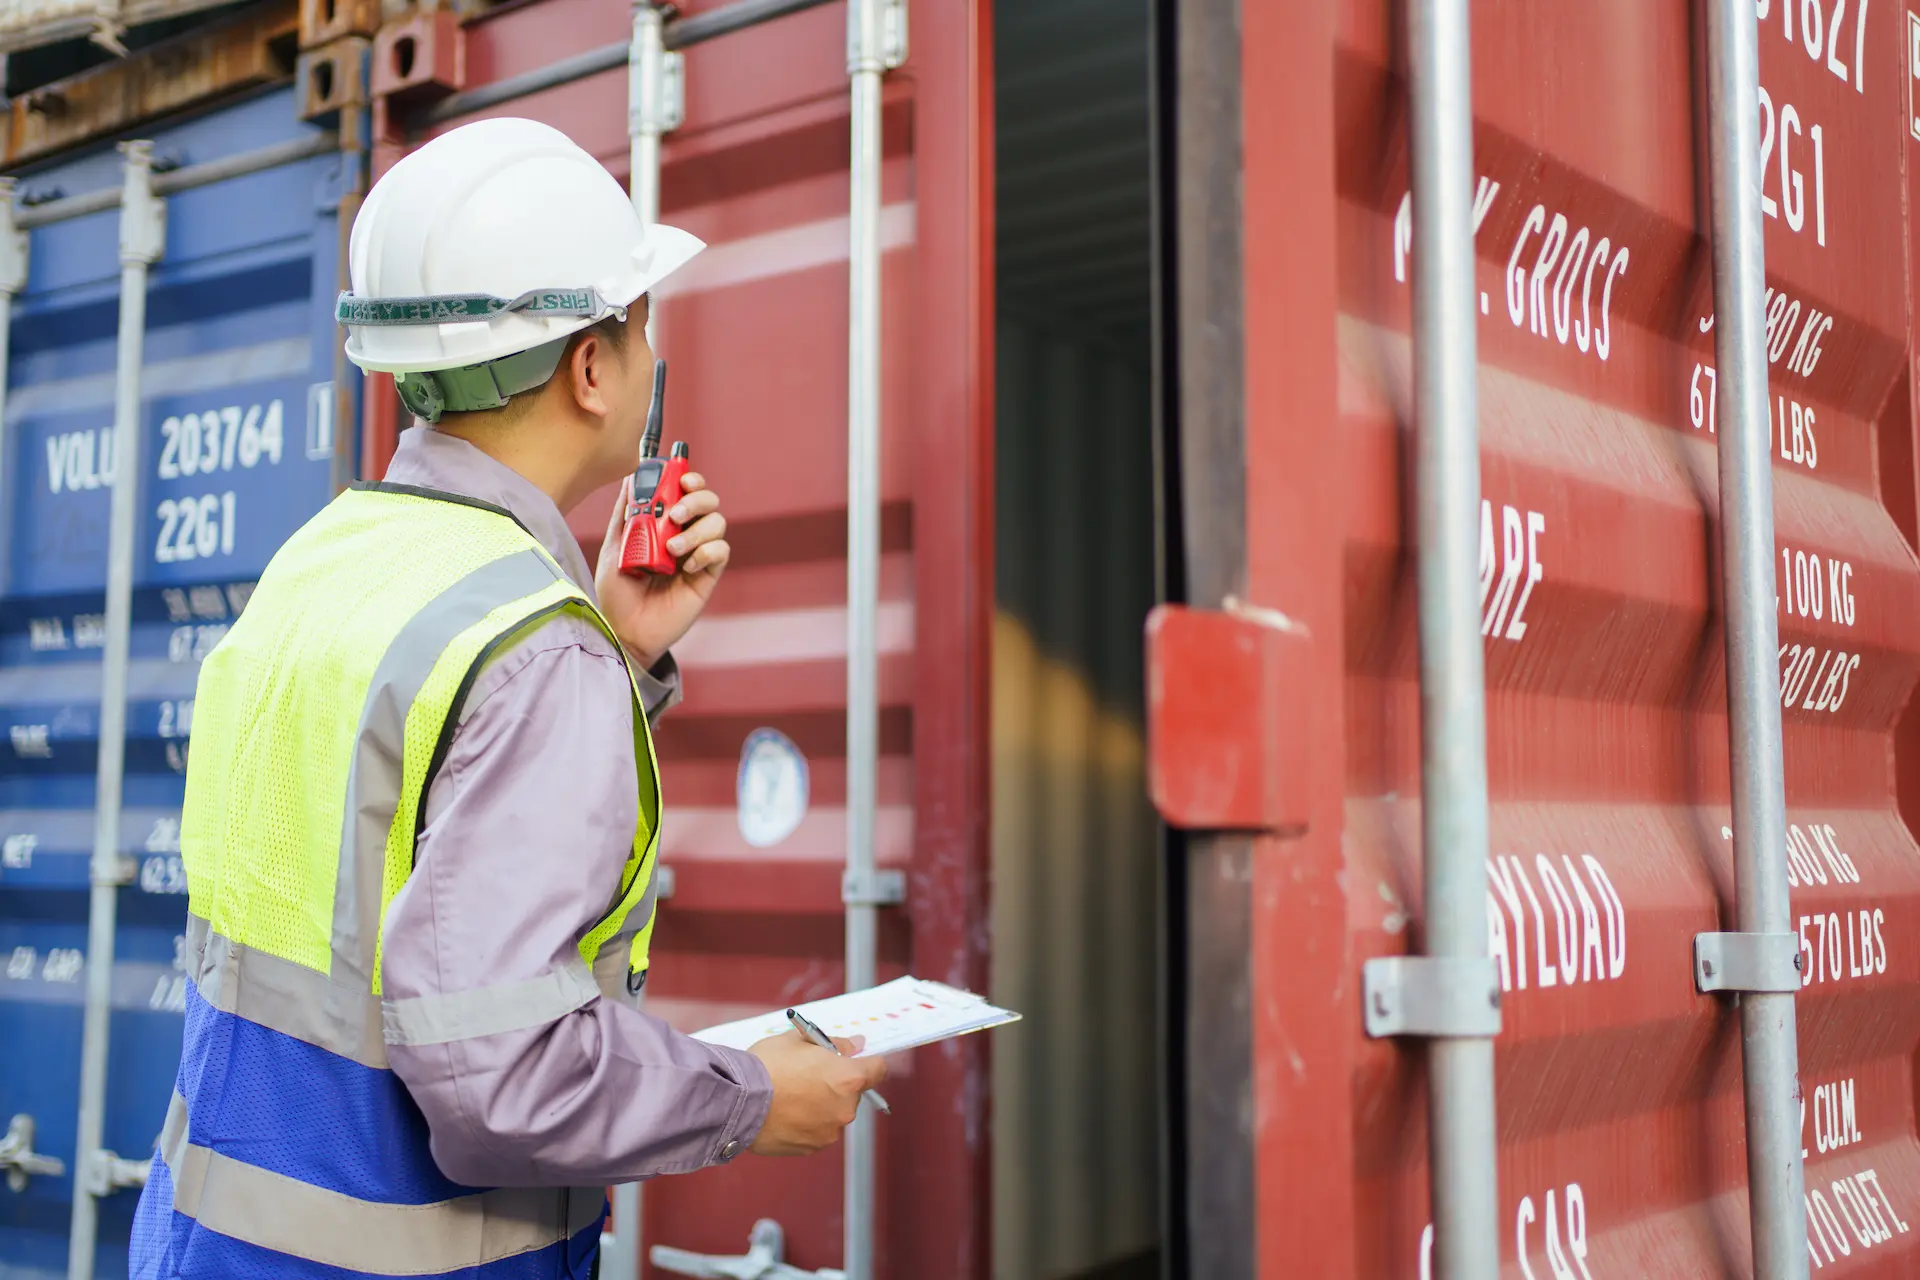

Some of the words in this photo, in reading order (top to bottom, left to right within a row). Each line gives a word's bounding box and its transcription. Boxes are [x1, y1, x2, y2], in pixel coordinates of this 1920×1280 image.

[1758, 86, 1825, 247] 2G1
[527, 293, 590, 312] FIRST
[1507, 204, 1630, 360] GROSS
[1787, 308, 1833, 377] KG
[158, 399, 284, 480] 203764
[1779, 395, 1818, 469] LBS
[155, 490, 236, 563] 22G1
[1479, 499, 1545, 642] ARE
[1776, 547, 1823, 620] 100
[1828, 558, 1855, 627] KG
[1802, 649, 1861, 713] LBS
[1808, 824, 1860, 884] KG
[1484, 853, 1626, 992] AYLOAD
[1848, 907, 1887, 978] LBS
